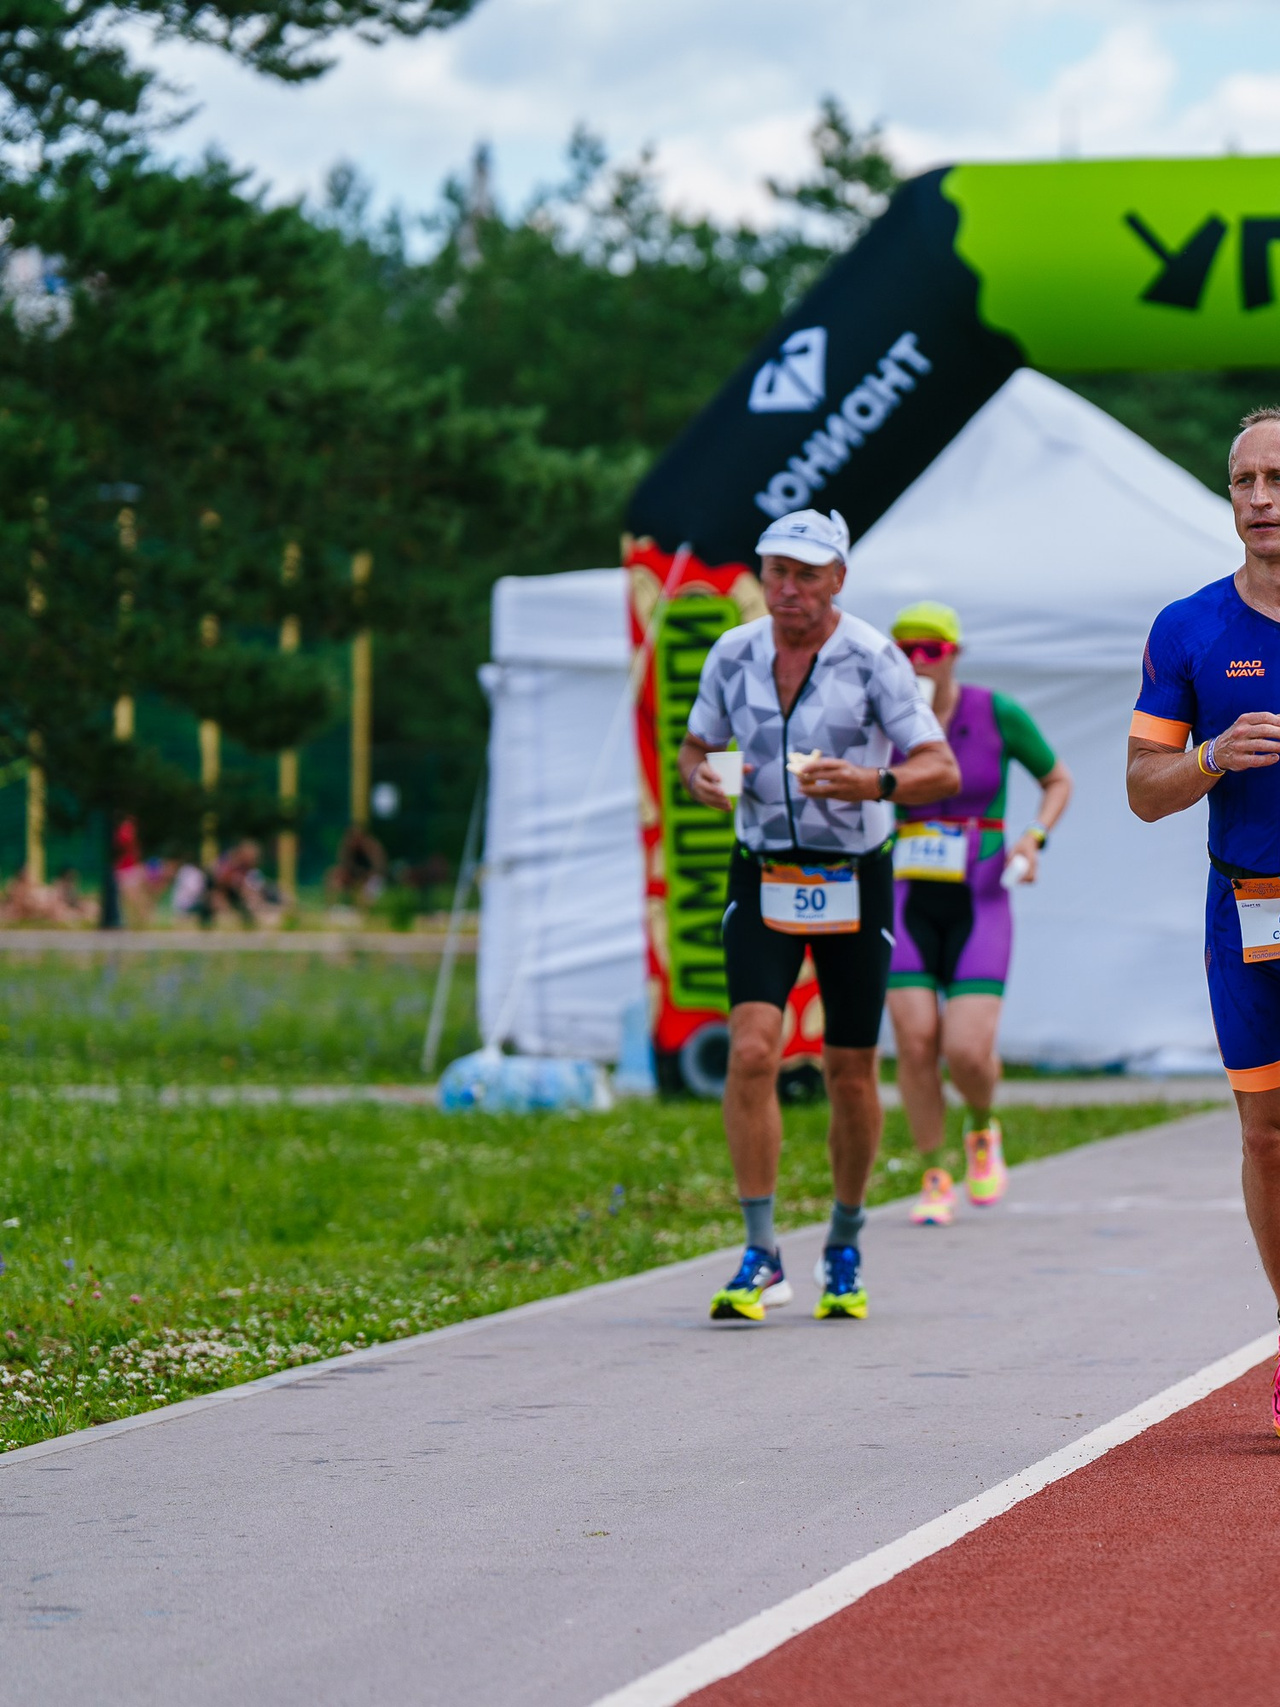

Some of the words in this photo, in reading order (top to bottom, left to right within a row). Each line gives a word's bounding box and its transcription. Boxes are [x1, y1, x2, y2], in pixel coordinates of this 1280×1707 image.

[1230, 660, 1263, 669] MAD
[1225, 668, 1266, 678] WAVE
[794, 887, 827, 912] 50
